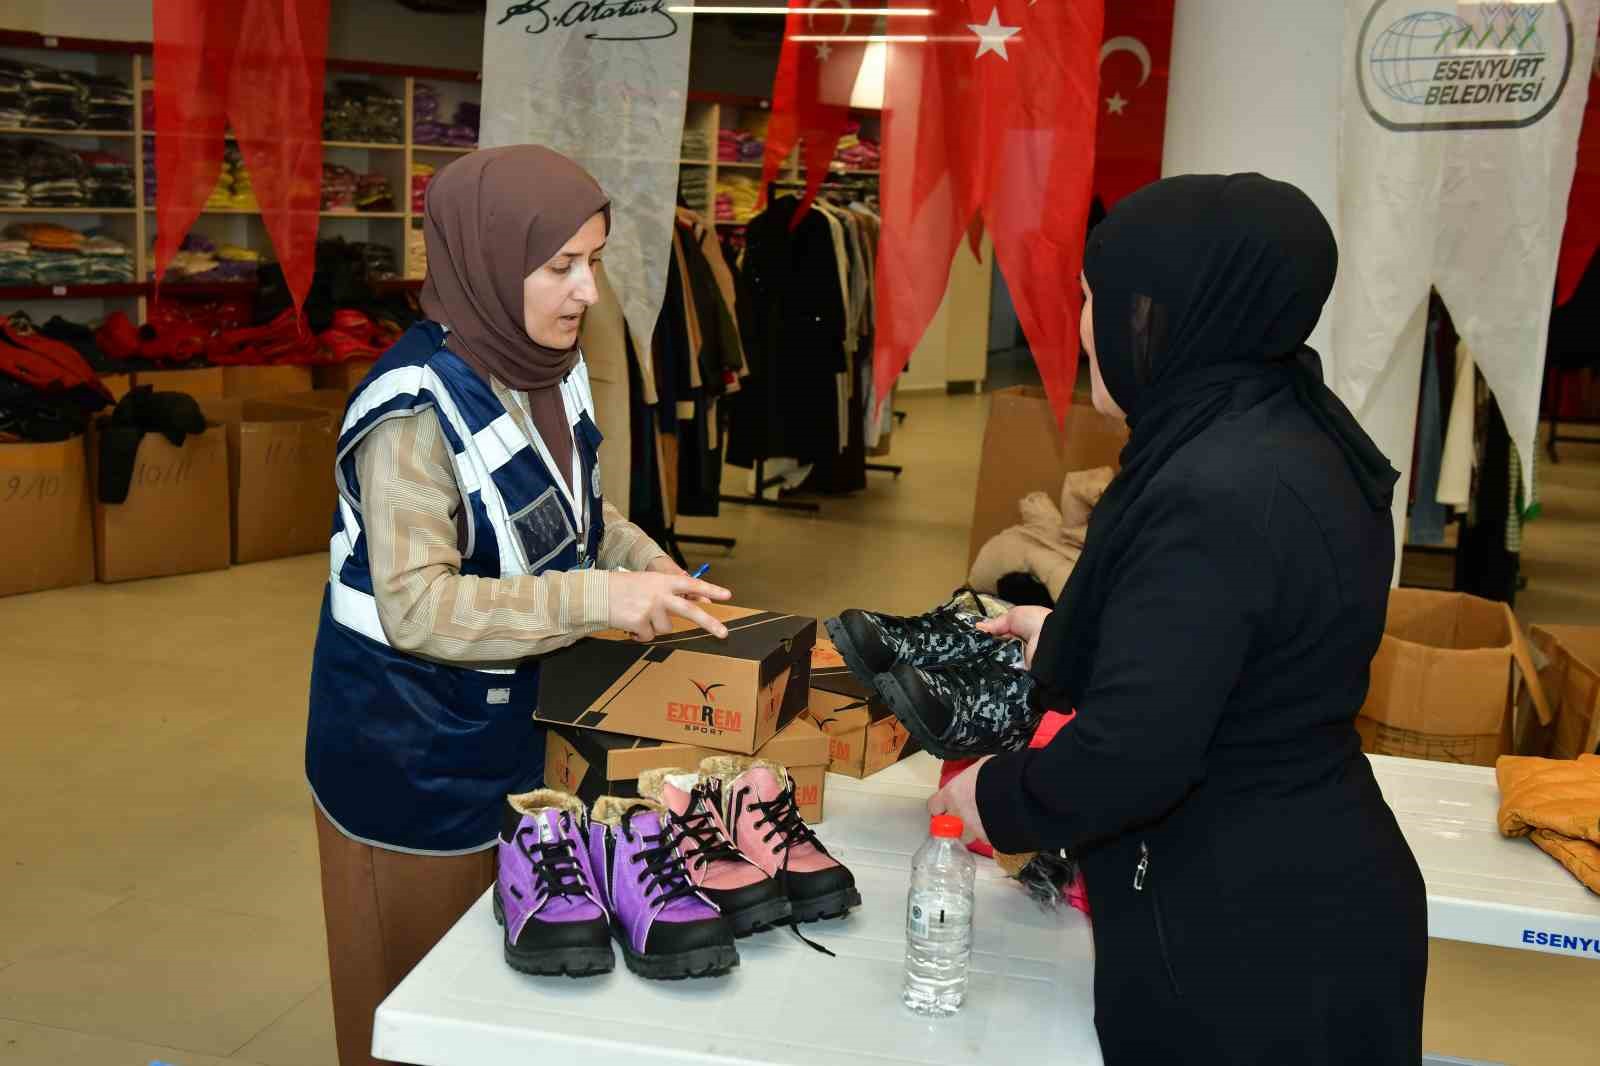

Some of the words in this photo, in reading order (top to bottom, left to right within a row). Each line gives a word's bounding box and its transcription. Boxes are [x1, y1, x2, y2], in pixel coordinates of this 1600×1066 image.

[1432, 58, 1544, 81] ESENYURT
[1424, 76, 1545, 105] BELEDİYESİ
[666, 702, 742, 731] EXTREM
[684, 724, 724, 736] SPORT
